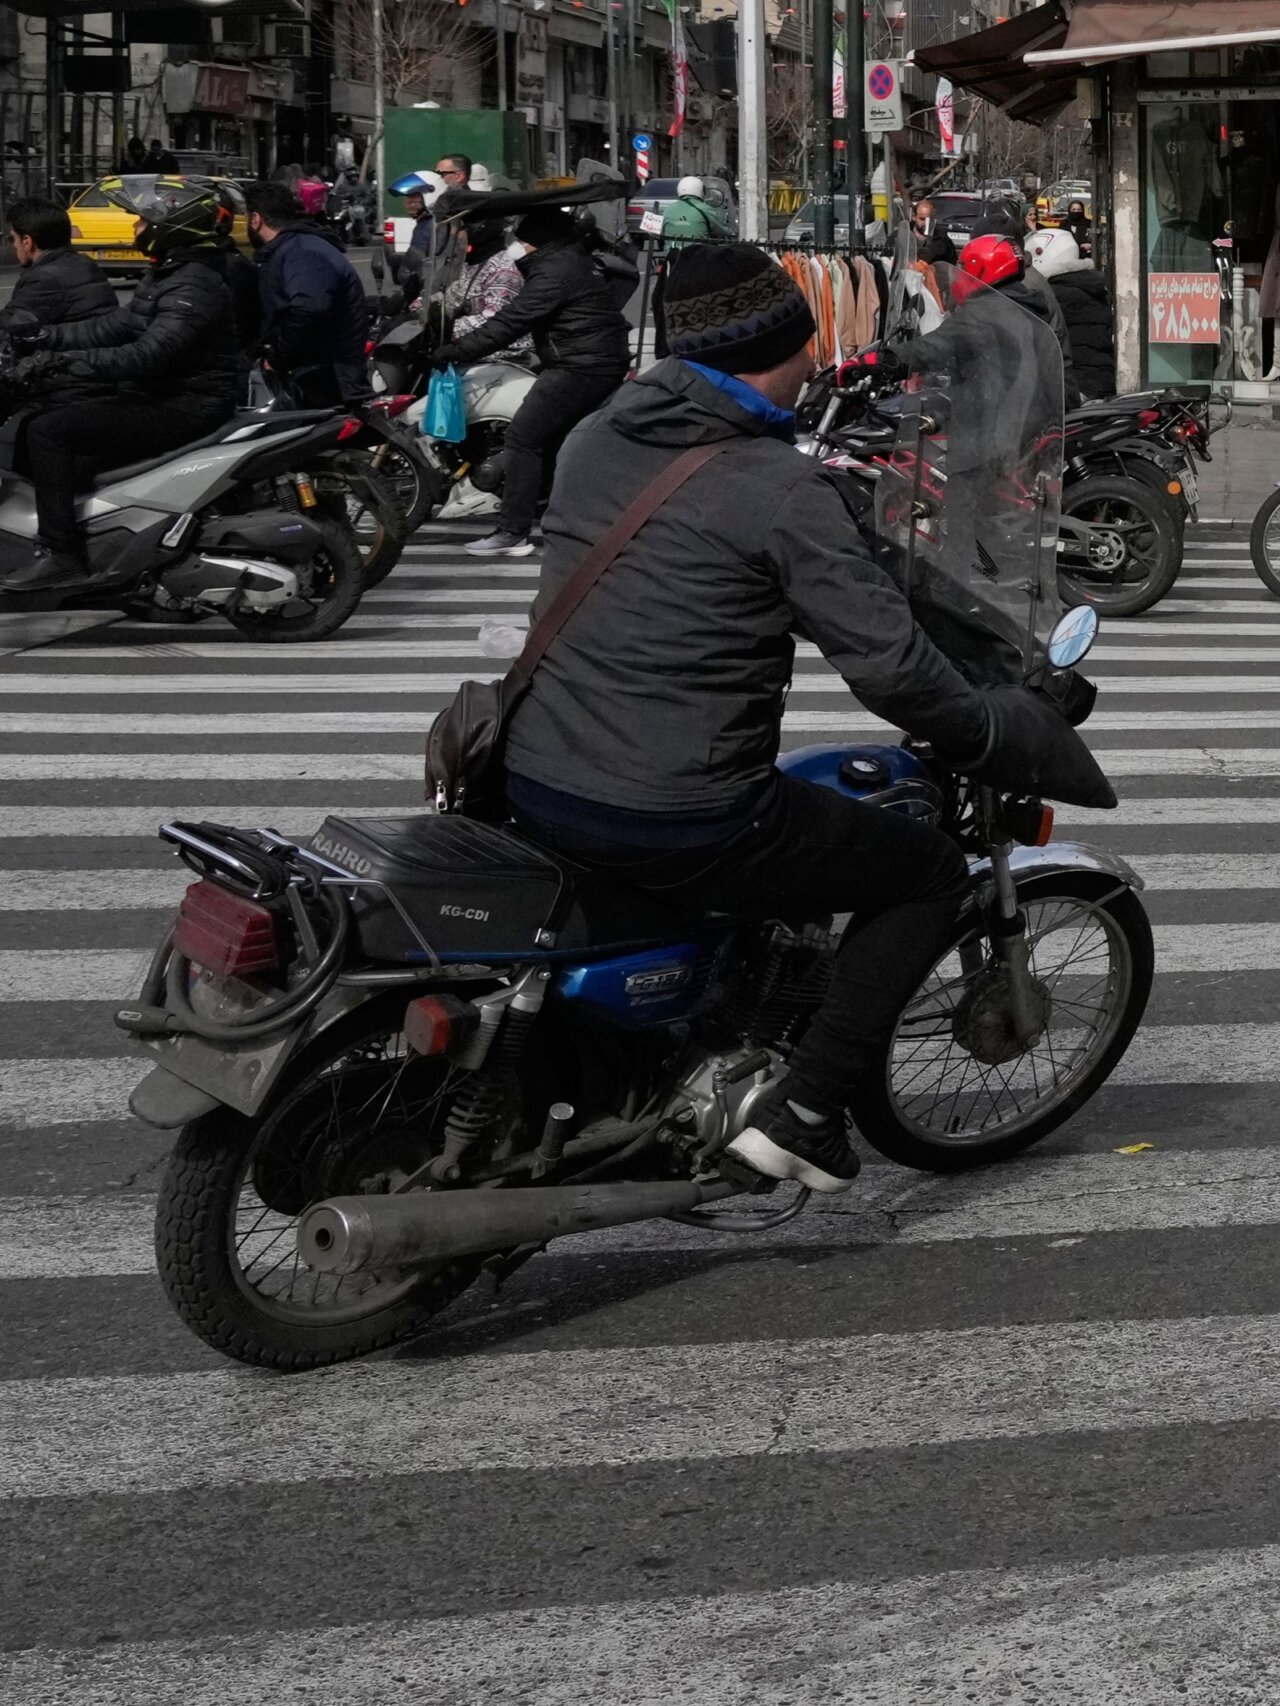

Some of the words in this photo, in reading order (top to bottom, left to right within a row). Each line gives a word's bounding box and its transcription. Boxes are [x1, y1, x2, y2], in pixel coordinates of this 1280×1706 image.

[1152, 301, 1218, 340] ۴۸۵۰۰۰
[311, 832, 372, 875] RAHRO
[439, 904, 490, 922] KG-CDI
